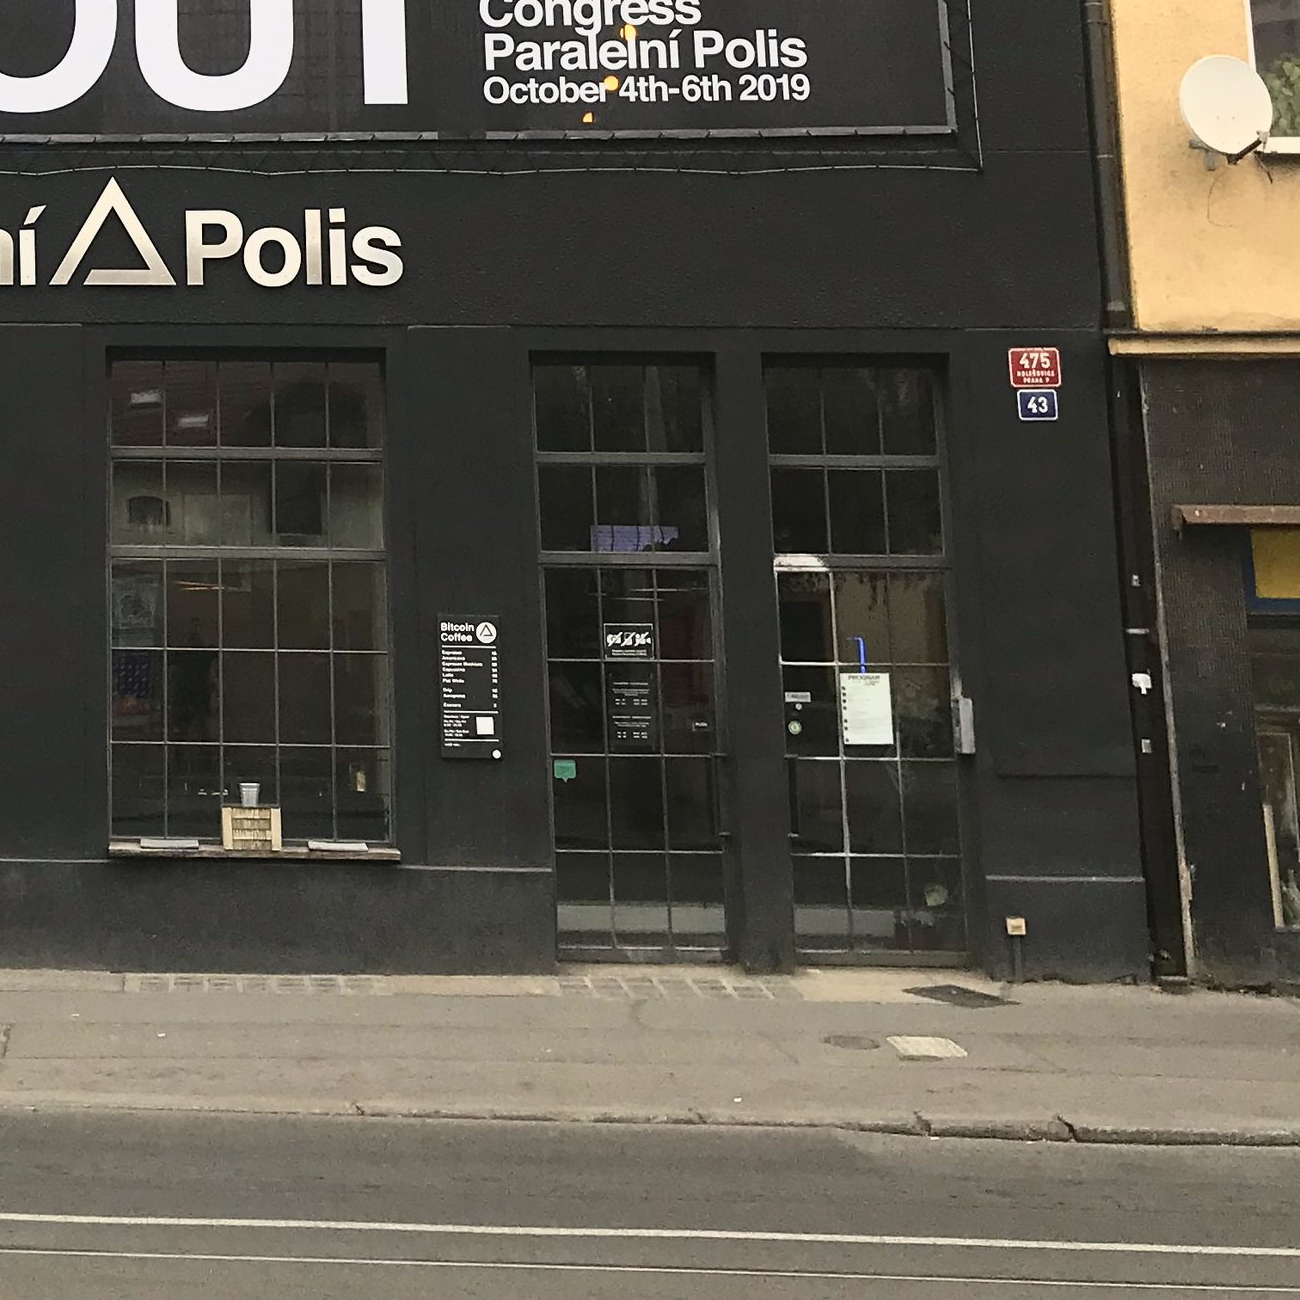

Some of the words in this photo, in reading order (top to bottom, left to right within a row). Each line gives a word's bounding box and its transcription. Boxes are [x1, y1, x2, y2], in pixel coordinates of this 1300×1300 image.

[483, 28, 683, 71] Paralelní
[693, 28, 809, 70] Polis
[482, 75, 609, 105] October
[618, 74, 733, 103] 4th-6th
[739, 73, 812, 102] 2019
[185, 207, 405, 288] Polis
[1019, 352, 1051, 369] 475
[1027, 396, 1048, 414] 43
[440, 621, 475, 632] Bitcoin
[440, 632, 473, 642] Coffee
